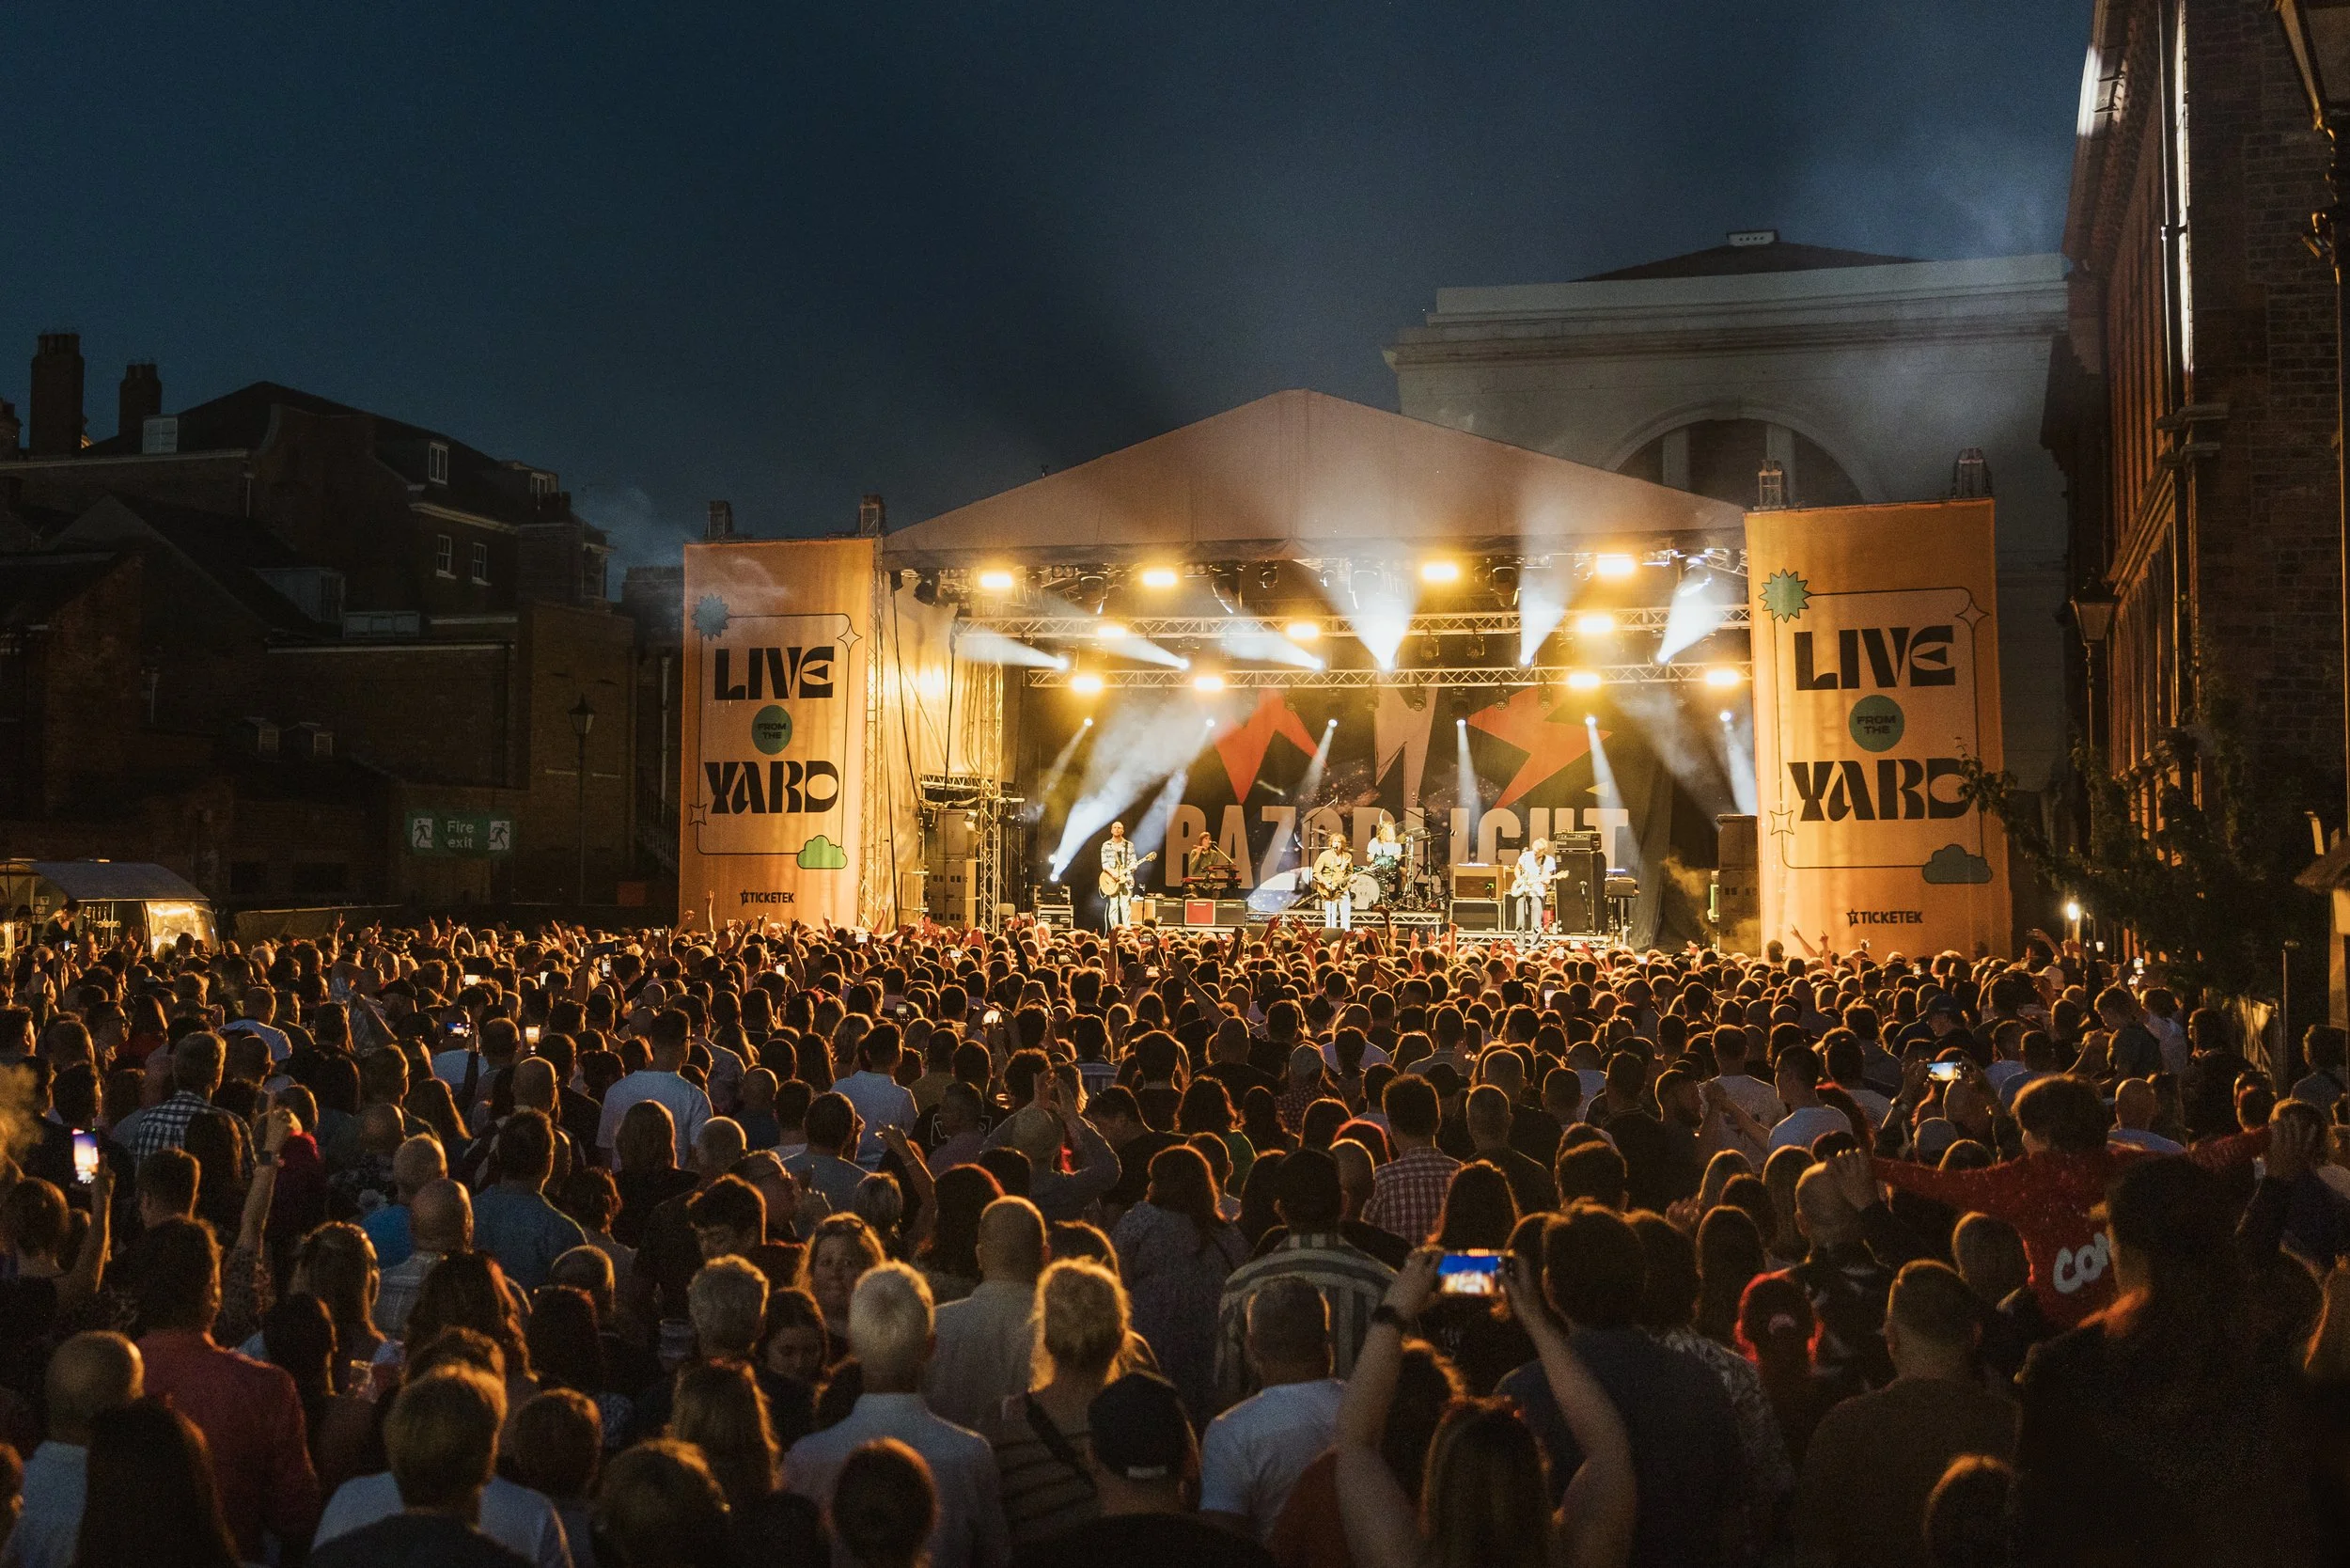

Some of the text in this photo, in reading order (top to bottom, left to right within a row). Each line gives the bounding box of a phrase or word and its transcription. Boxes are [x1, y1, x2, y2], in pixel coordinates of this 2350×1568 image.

[1794, 625, 1956, 690] LIVE
[714, 647, 835, 700] LIVE
[758, 722, 788, 730] FROM
[1856, 715, 1897, 725] FROM
[762, 731, 783, 740] THE
[1863, 725, 1891, 734] THE
[704, 760, 838, 815] YARD
[1788, 758, 1975, 822] YARD
[446, 820, 475, 834] Fire
[447, 836, 474, 849] exit
[749, 892, 795, 903] TICKETEK
[1859, 911, 1924, 924] TICKETEK
